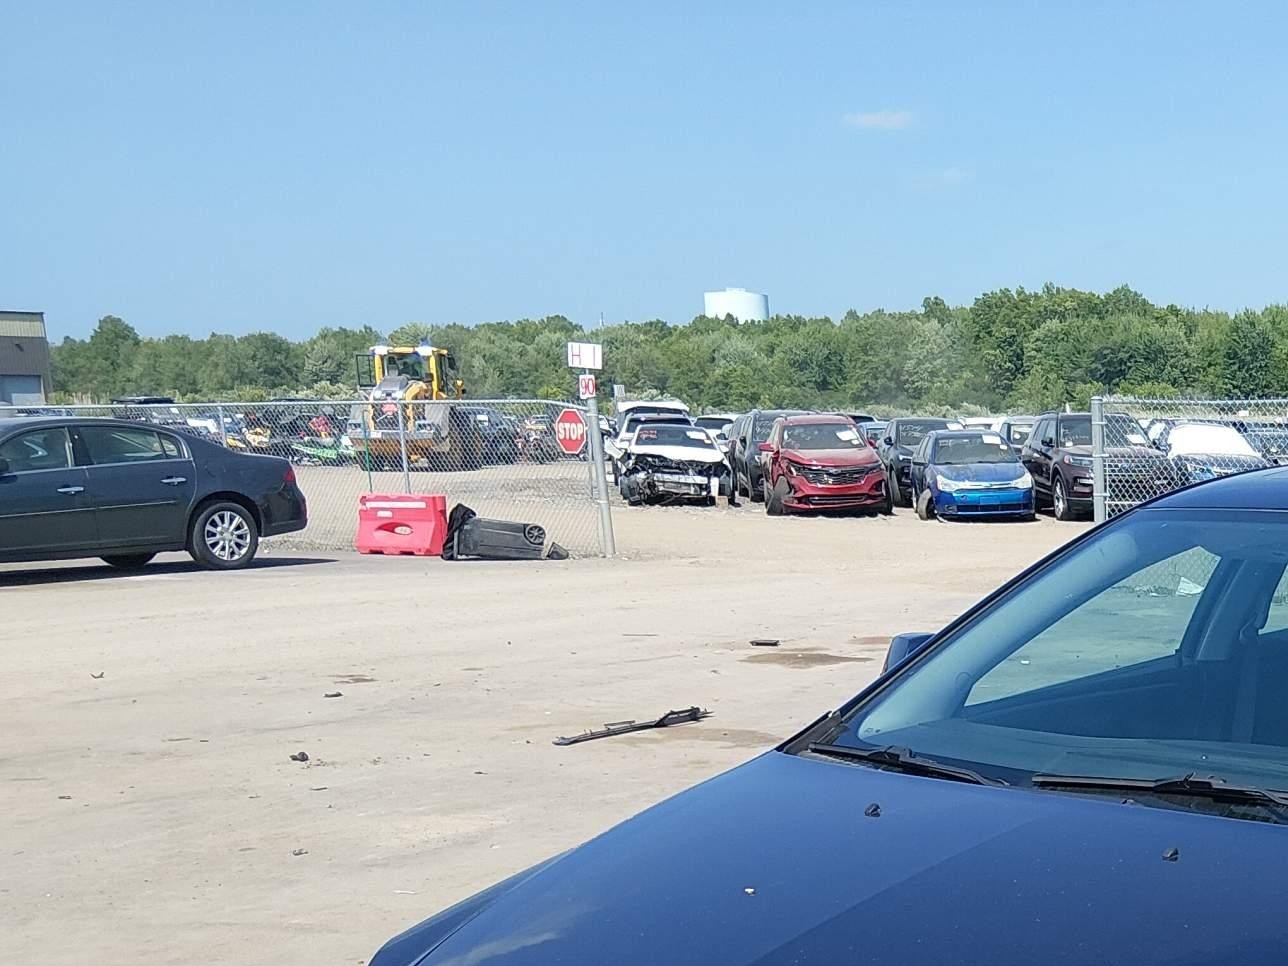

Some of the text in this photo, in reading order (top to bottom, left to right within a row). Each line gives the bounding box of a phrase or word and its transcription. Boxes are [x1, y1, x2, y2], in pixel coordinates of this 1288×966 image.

[571, 343, 582, 366] H
[580, 377, 595, 396] 90
[558, 422, 584, 441] STOP
